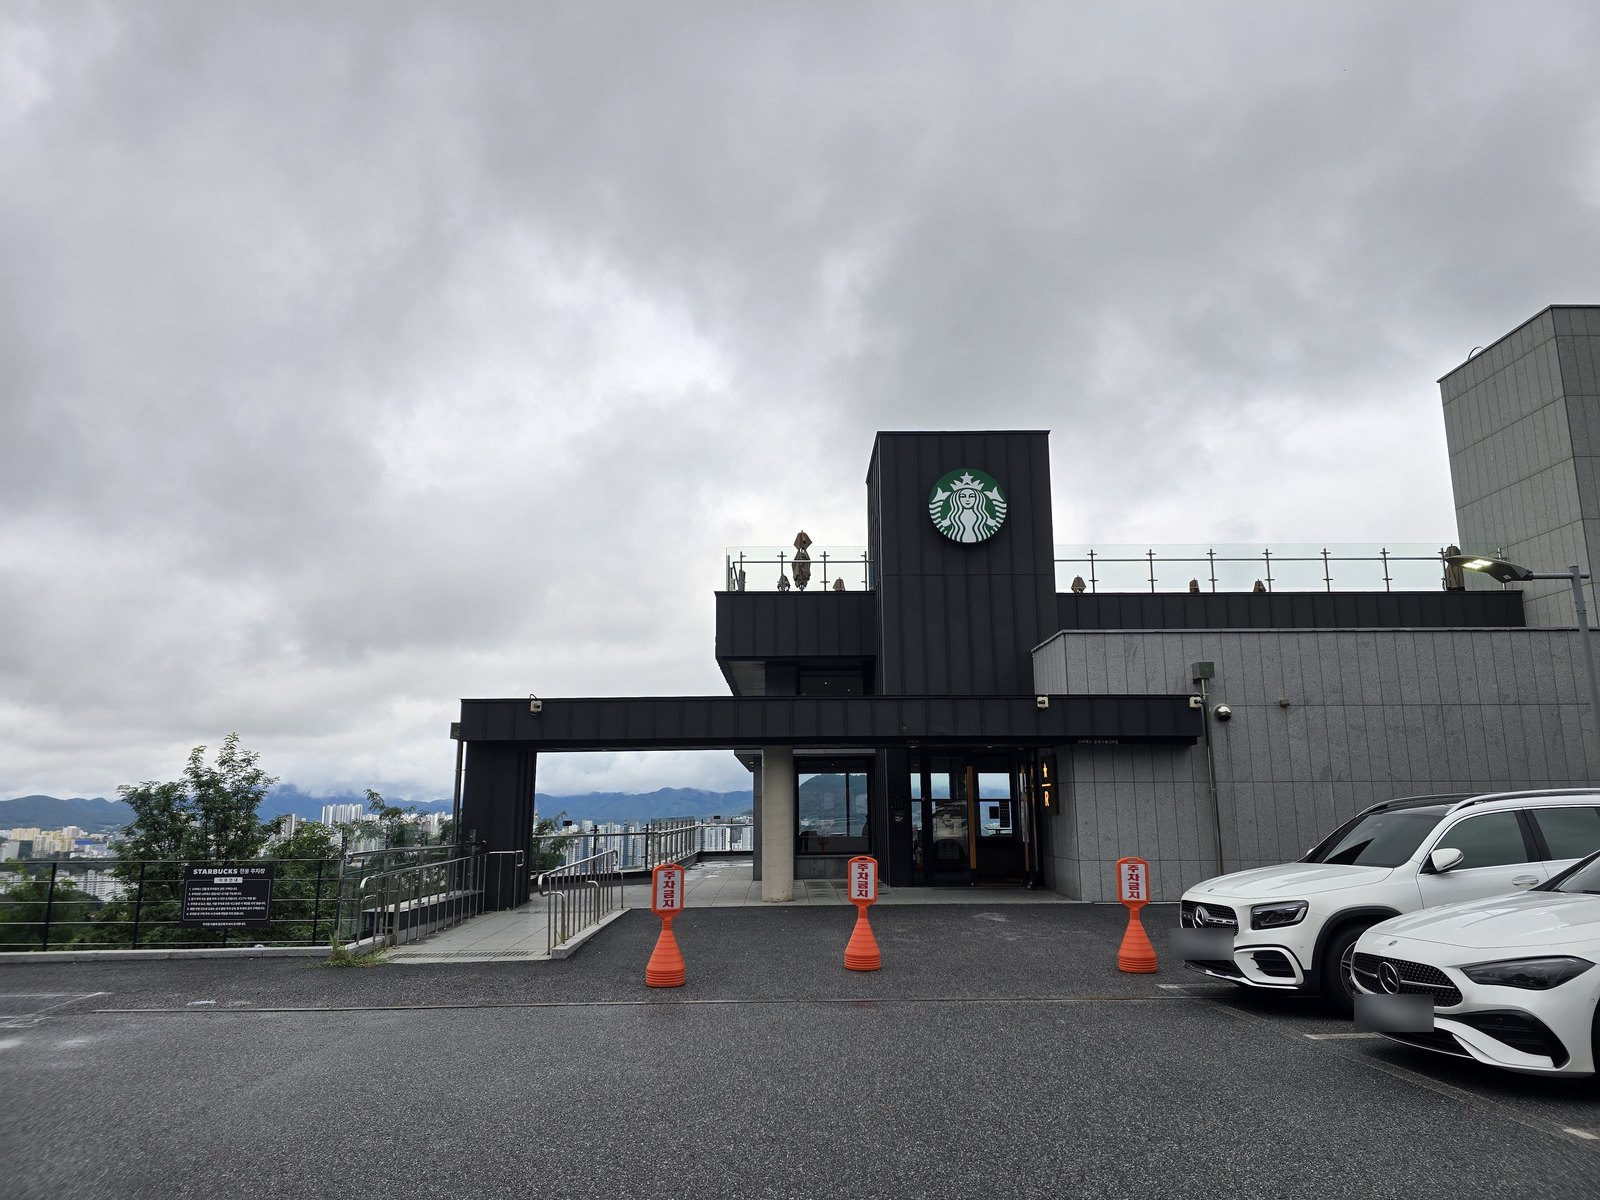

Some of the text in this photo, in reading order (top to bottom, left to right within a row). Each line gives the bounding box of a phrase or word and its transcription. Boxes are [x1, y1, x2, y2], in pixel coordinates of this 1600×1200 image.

[662, 870, 676, 909] 주차금지
[856, 863, 870, 898] 주차금지
[1127, 864, 1140, 900] 주차금지
